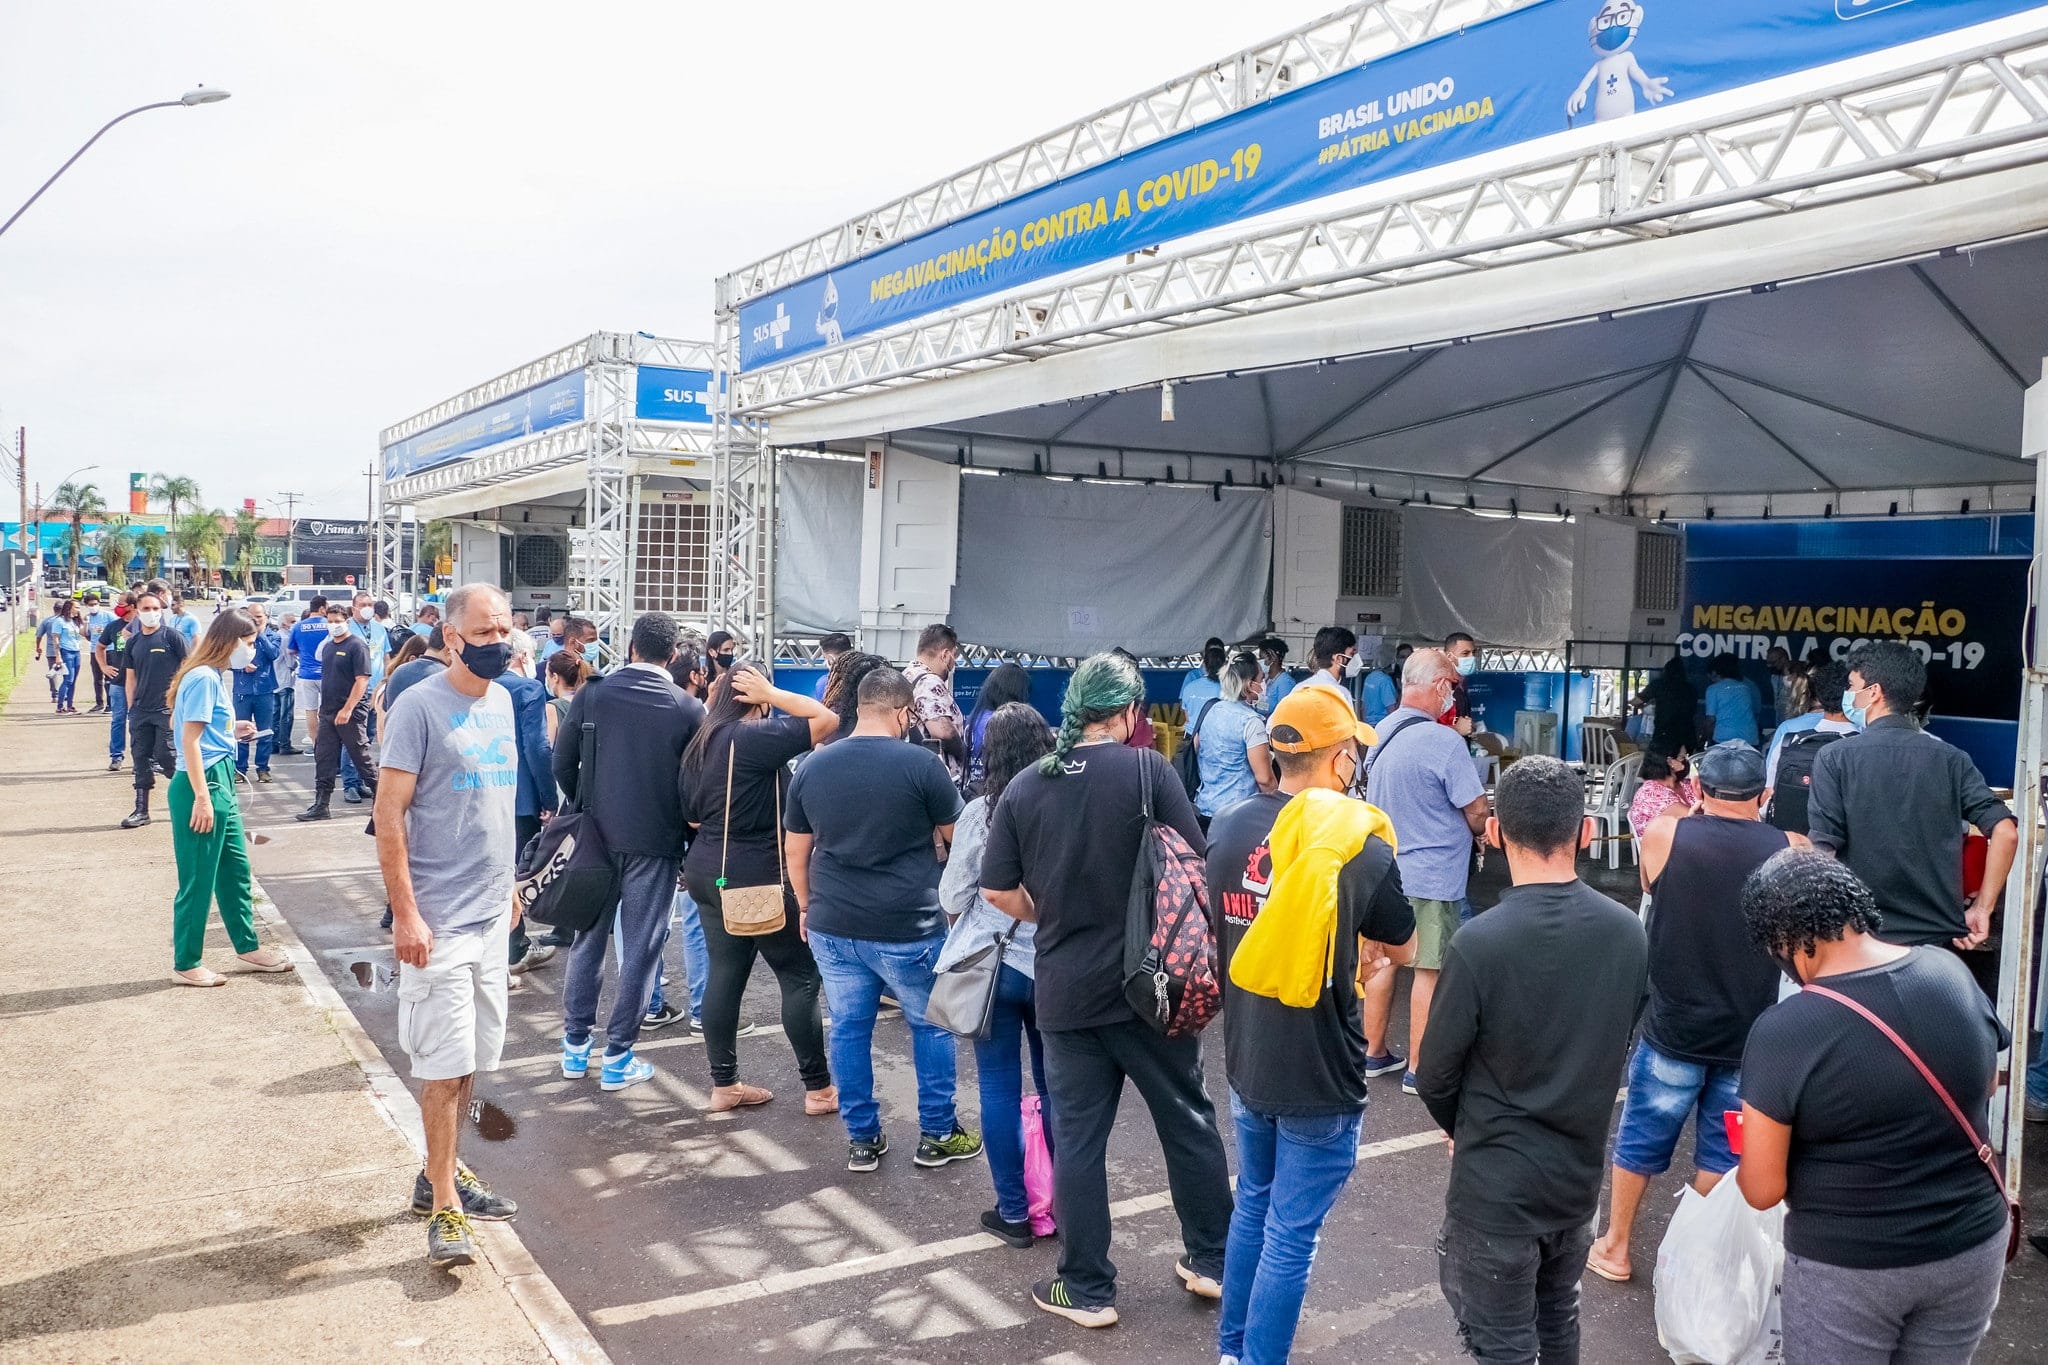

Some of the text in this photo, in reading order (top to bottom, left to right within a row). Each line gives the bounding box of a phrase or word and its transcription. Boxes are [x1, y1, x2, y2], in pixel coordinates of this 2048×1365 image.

[1319, 76, 1455, 139] BRASIL UNIDO
[1318, 96, 1495, 165] #PÁTRIA VACINADA
[870, 143, 1262, 304] MEGAVACINAÇÃO CONTRA A COVID-19
[753, 322, 769, 344] SUS
[663, 388, 694, 404] SUS
[324, 523, 354, 535] Fama
[1692, 601, 1966, 643] MEGAVACINAÇÃO
[1675, 632, 1793, 661] CONTRA
[1828, 637, 1986, 671] CD-19
